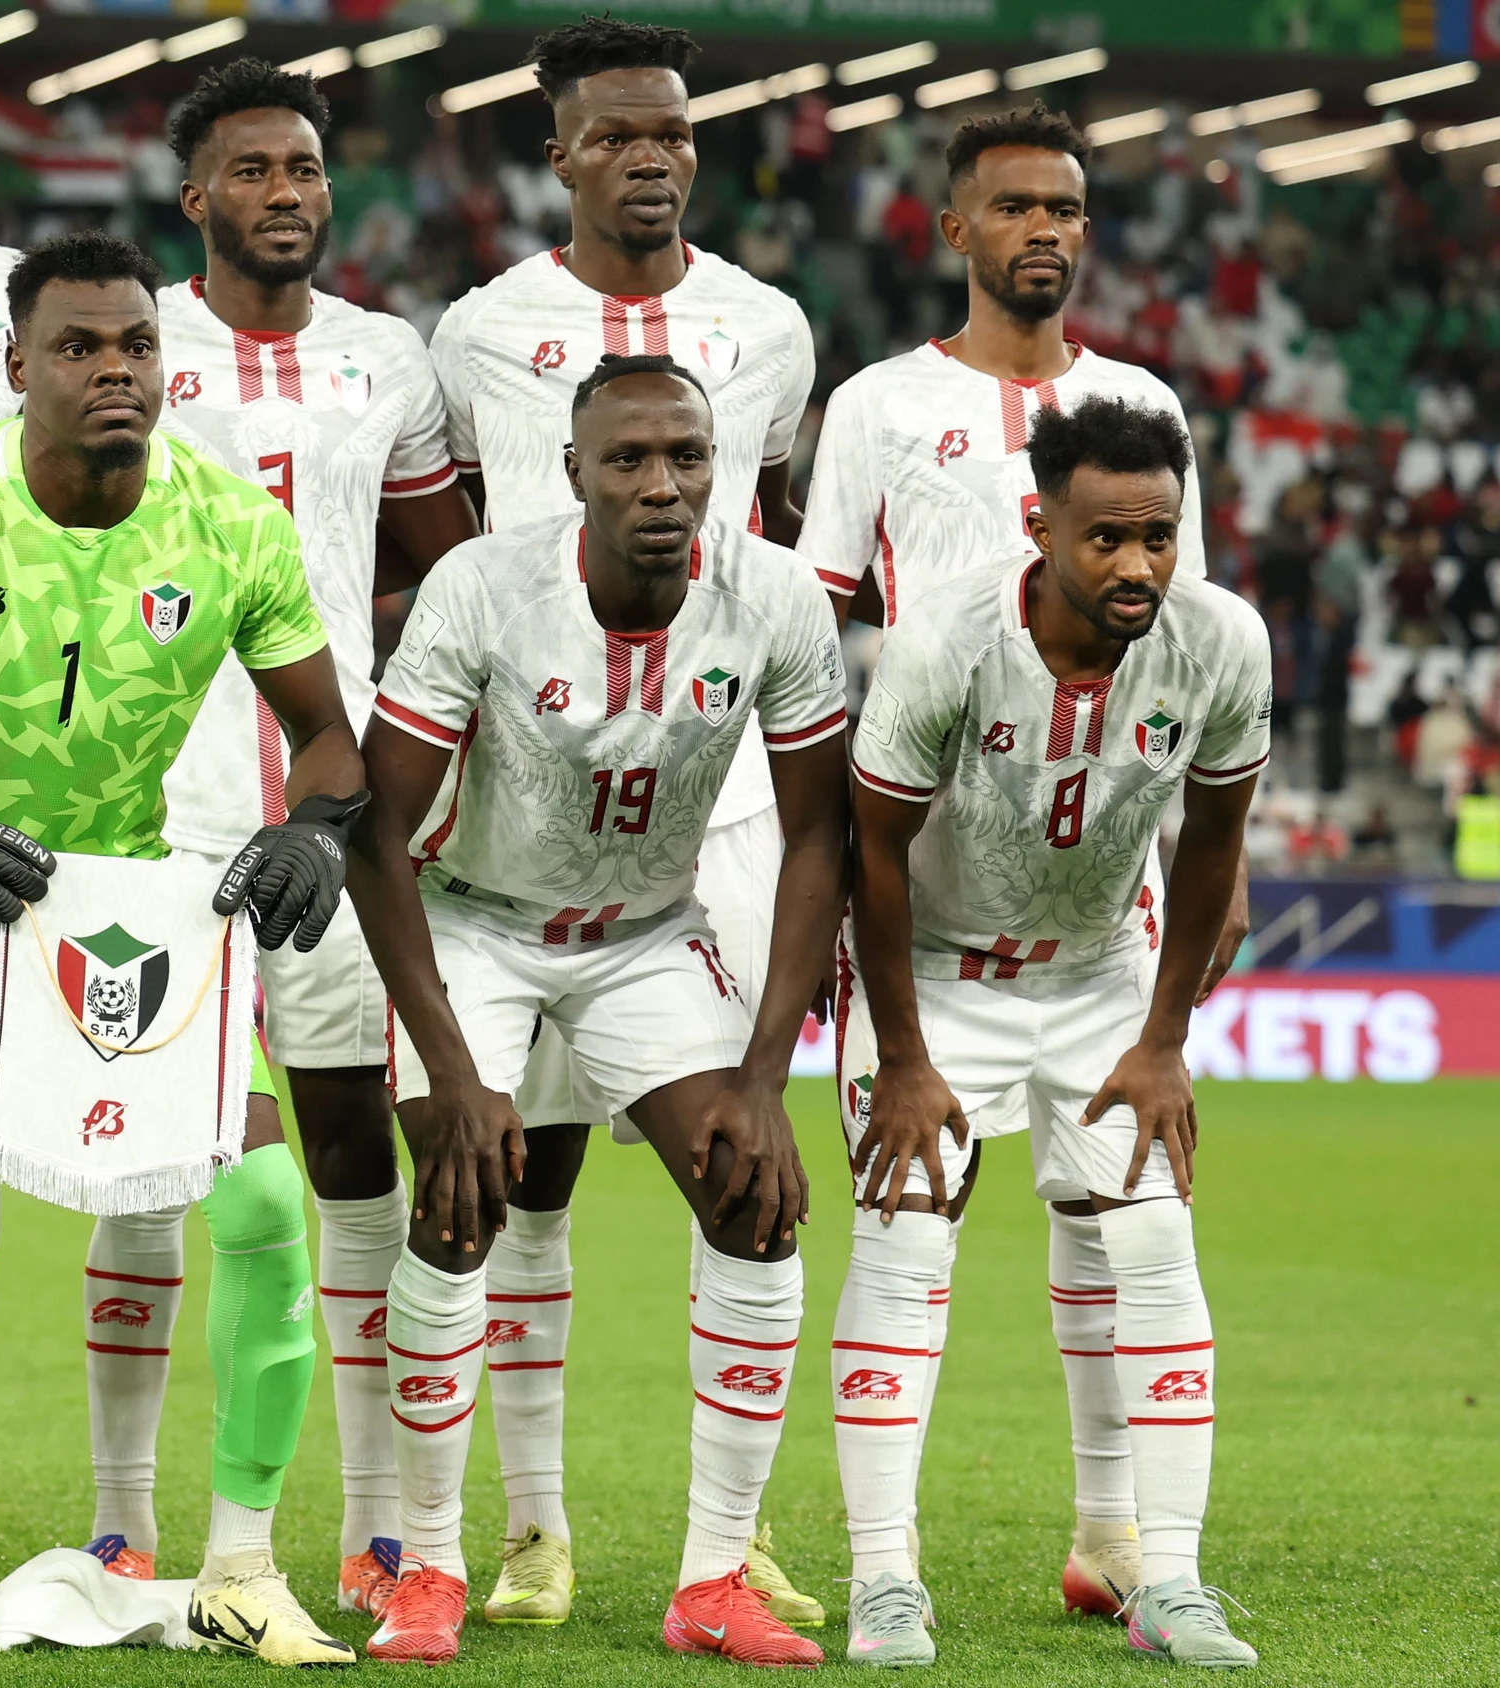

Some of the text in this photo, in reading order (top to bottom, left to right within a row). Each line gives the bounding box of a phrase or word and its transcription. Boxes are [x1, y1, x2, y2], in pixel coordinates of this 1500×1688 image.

[58, 641, 80, 728] 1
[589, 767, 657, 835] 19
[1045, 768, 1088, 850] 8
[220, 844, 264, 902] REIGN
[90, 1023, 129, 1038] S.F.A
[83, 1099, 125, 1145] AB
